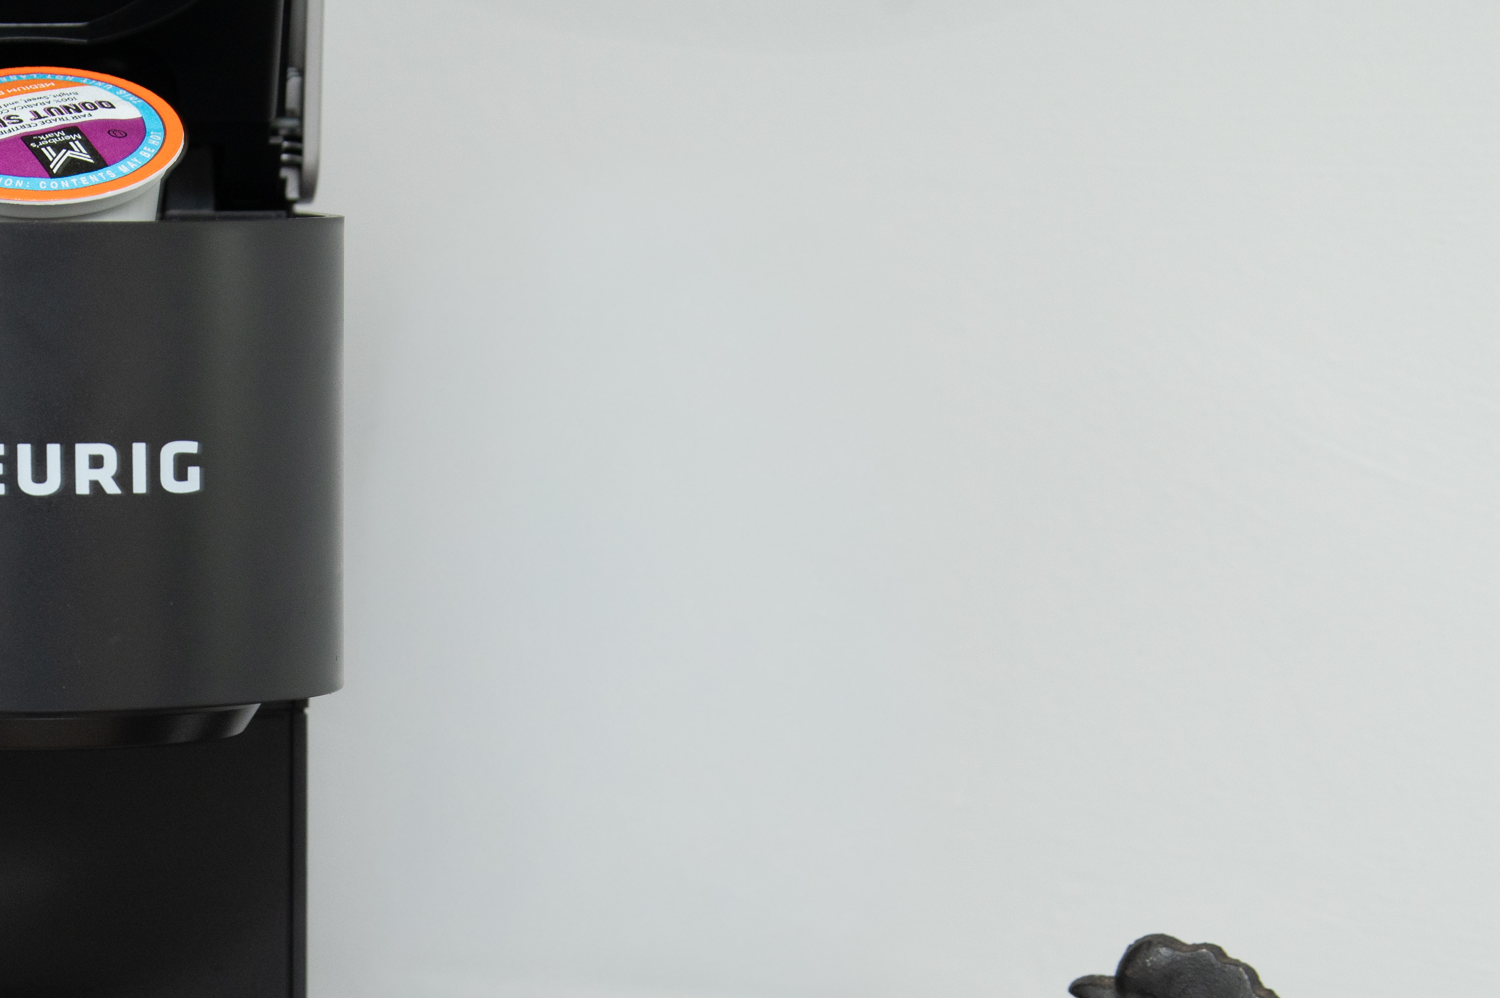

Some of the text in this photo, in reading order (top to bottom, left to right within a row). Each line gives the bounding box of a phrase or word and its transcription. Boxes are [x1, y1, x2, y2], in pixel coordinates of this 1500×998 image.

[6, 82, 56, 94] MEDIUM
[10, 100, 51, 111] ARABICA
[29, 100, 116, 121] DONUT
[40, 116, 70, 126] TRADE
[73, 112, 93, 121] FAIR
[30, 133, 82, 148] Member's
[39, 170, 117, 189] CONTENTS
[119, 157, 142, 174] MAY
[143, 145, 156, 159] BE
